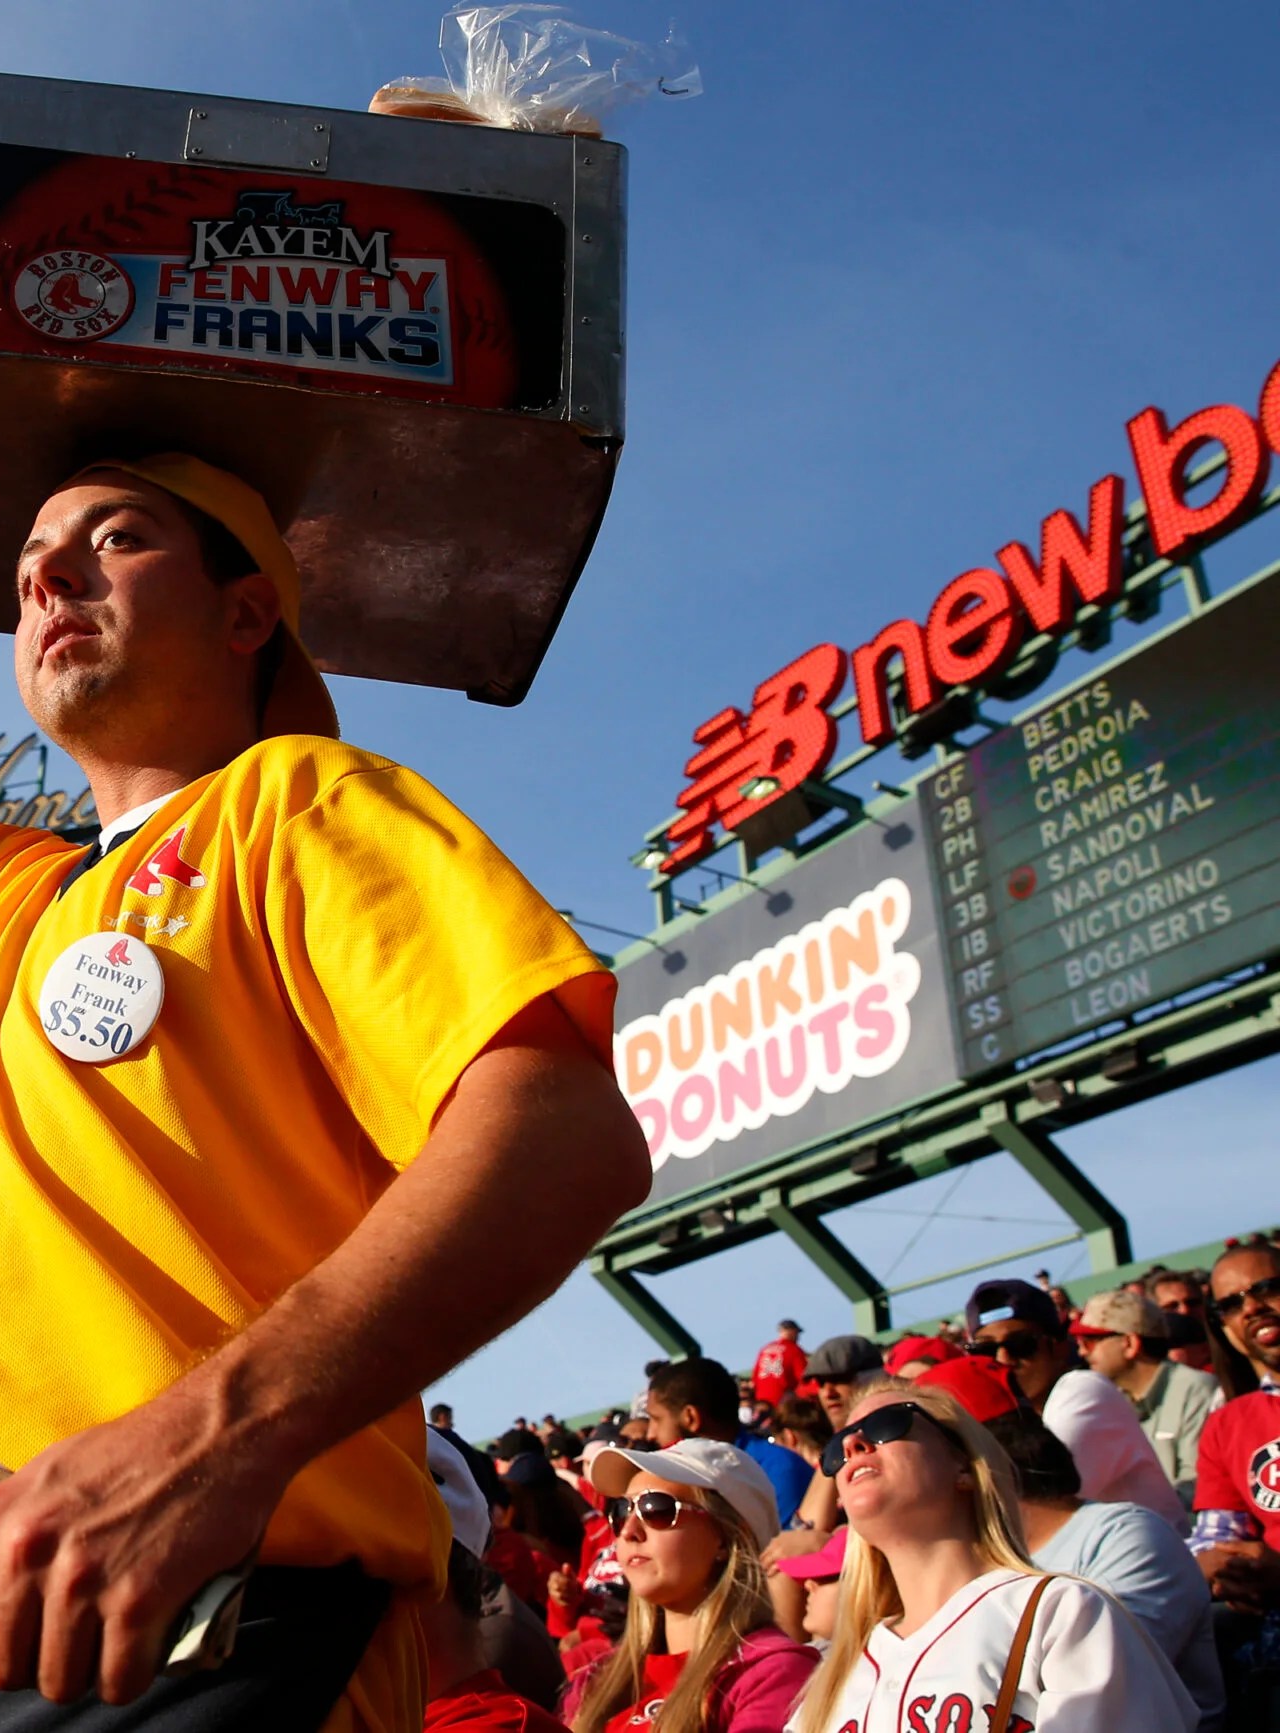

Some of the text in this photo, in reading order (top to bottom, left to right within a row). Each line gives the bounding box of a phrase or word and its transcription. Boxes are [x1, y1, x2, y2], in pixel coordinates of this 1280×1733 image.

[27, 251, 121, 284] BOSTON
[158, 262, 436, 313] FENWAY
[189, 220, 393, 278] KAYEM
[21, 303, 119, 337] RED SOX
[154, 303, 441, 367] FRANKS
[851, 473, 1126, 748] new
[934, 680, 1112, 800] CF BETTS
[940, 700, 1151, 833] 2B PEDROIA
[943, 749, 1123, 864] PH CRAIG
[948, 761, 1170, 896] LF RAMIREZ
[953, 782, 1215, 929] 3B SANDOVAL
[963, 858, 1220, 998] RF VICTORINO
[1052, 844, 1162, 917] NAPOLI
[70, 982, 128, 1018] Frank
[74, 953, 148, 995] Fenway
[625, 896, 896, 1096] DUNKIN'
[967, 895, 1233, 1031] SS BOGAERTS
[44, 999, 134, 1055] $5.50
[980, 970, 1152, 1062] C LEON
[632, 983, 896, 1158] DONUTS
